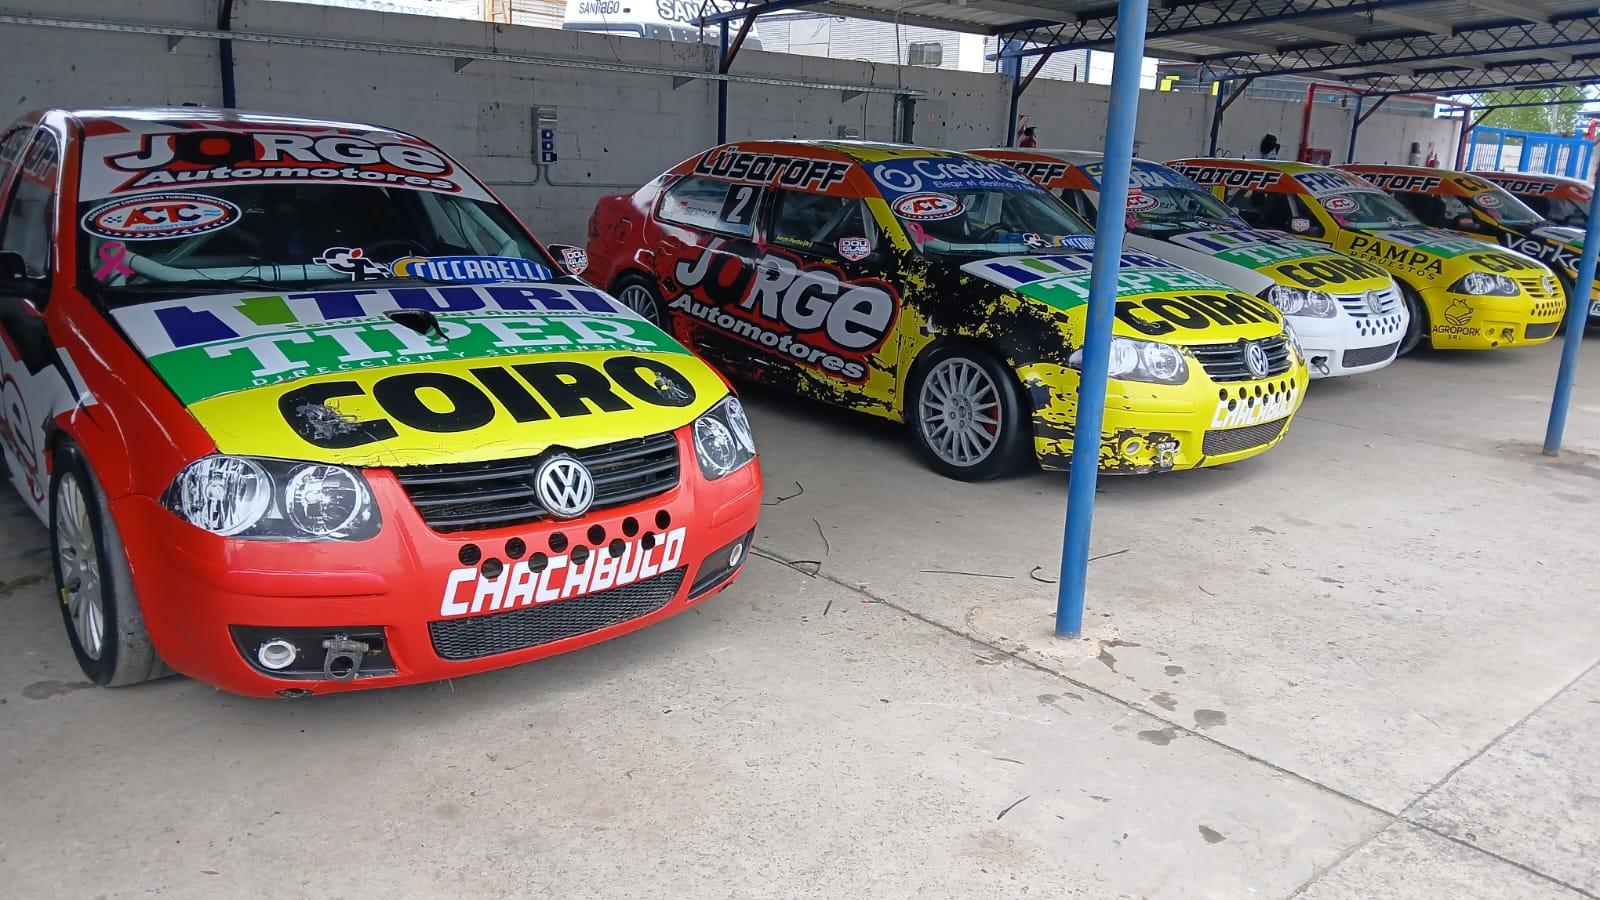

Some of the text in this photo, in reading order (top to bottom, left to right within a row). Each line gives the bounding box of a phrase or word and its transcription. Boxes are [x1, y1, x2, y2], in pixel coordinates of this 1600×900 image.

[132, 166, 454, 189] Automotores
[122, 203, 202, 228] ACTC
[726, 186, 753, 223] 2
[1349, 236, 1443, 274] PAMPA
[205, 317, 657, 378] TIPER
[668, 294, 864, 379] Automotores
[1432, 324, 1481, 336] AGROPORK
[278, 356, 696, 449] COIRO
[440, 526, 687, 617] CHACABUCO
